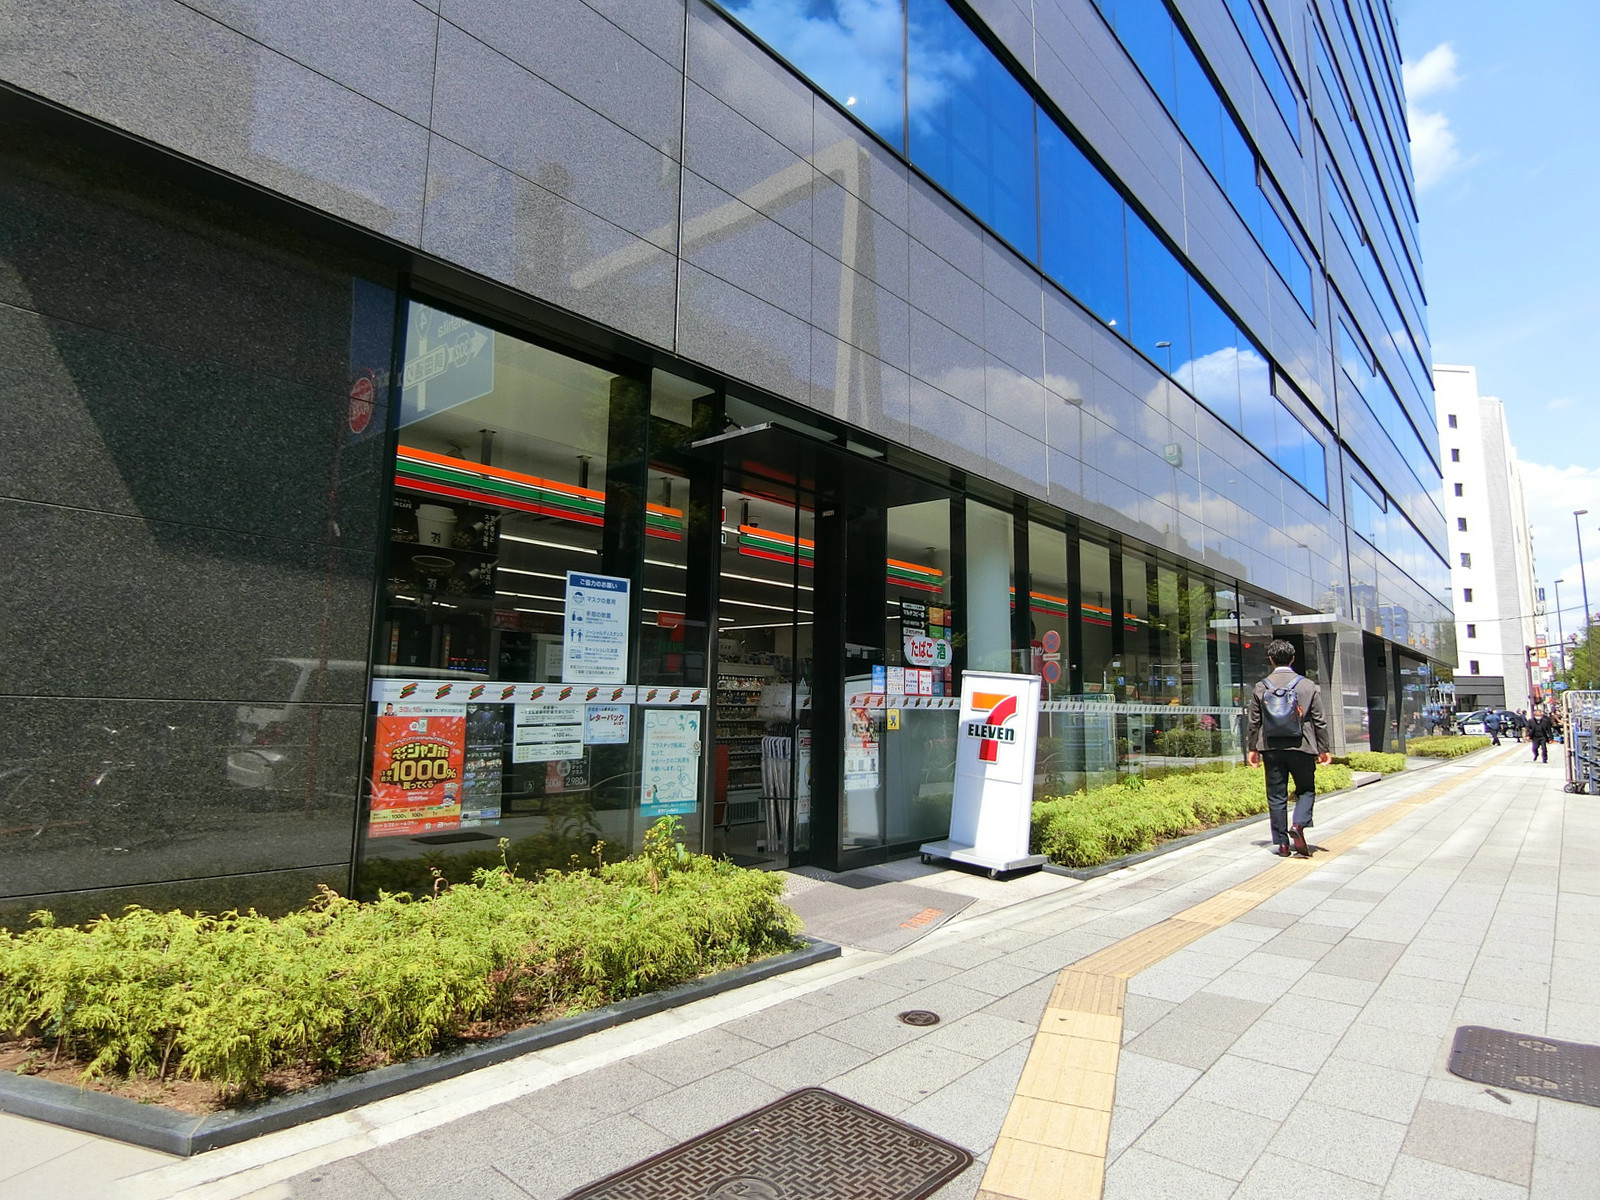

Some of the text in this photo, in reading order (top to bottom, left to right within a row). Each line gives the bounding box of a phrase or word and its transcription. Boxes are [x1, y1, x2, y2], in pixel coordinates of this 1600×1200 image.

[910, 639, 946, 660] たばこ 酒
[589, 713, 625, 722] レターパック
